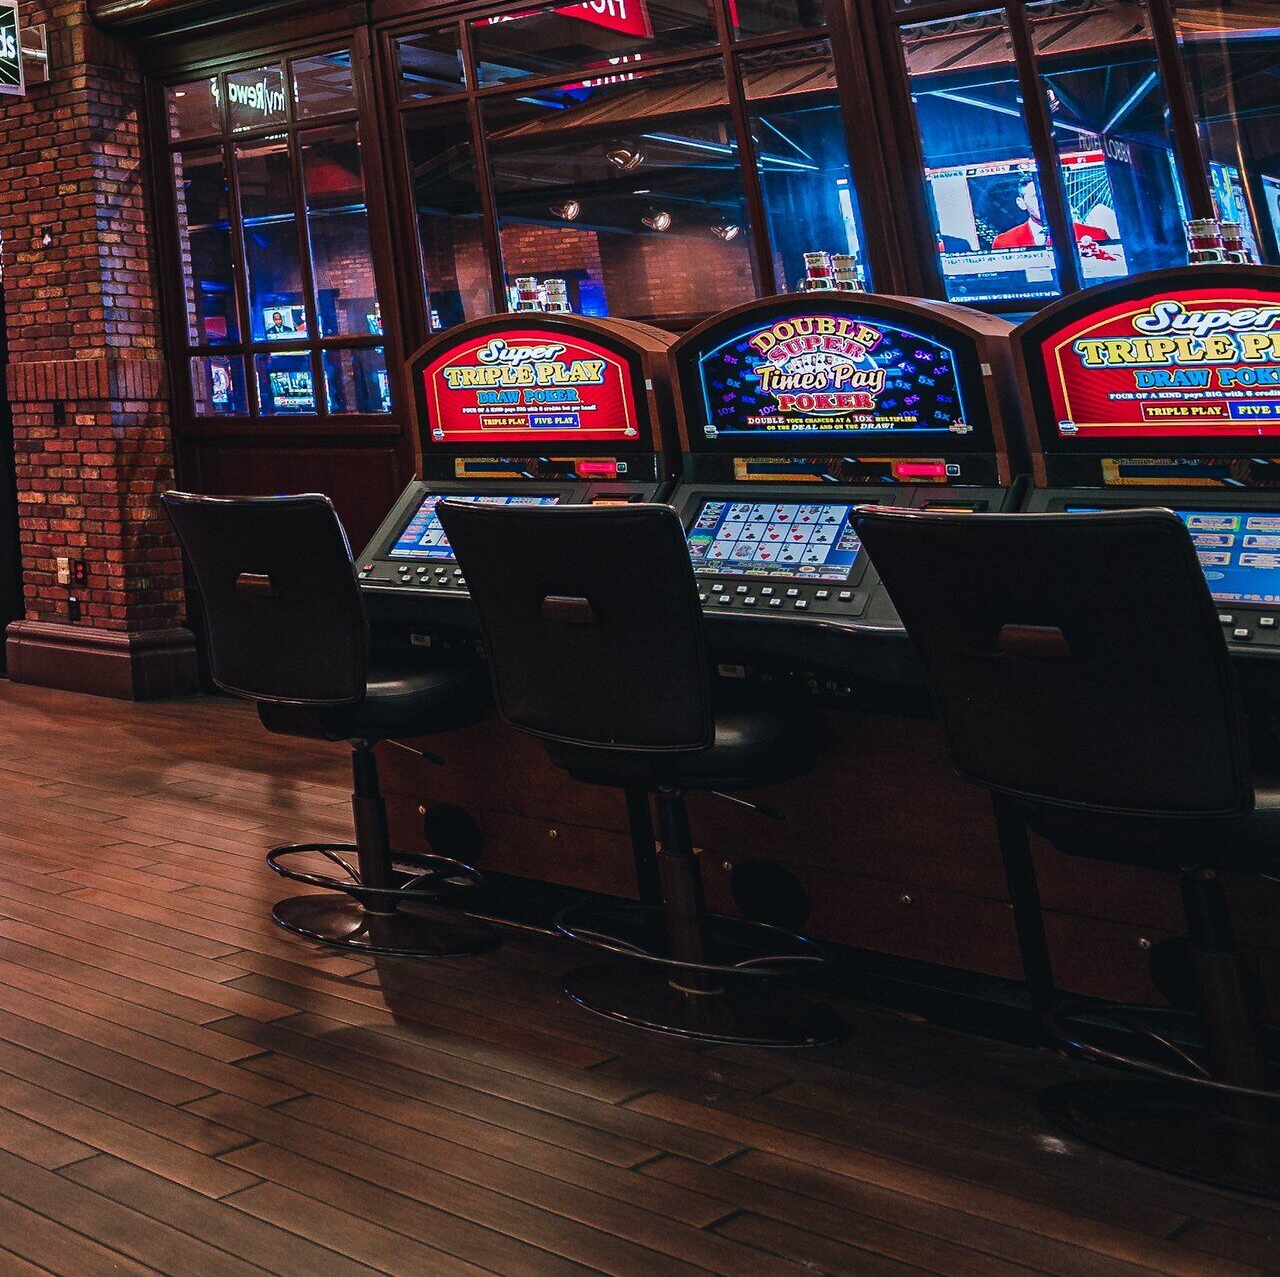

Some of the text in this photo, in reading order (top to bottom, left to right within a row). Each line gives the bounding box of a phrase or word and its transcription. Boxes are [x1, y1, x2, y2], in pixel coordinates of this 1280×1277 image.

[1133, 300, 1280, 335] Super
[749, 317, 881, 354] DOUBLE
[768, 334, 866, 363] SUPER
[478, 339, 566, 365] Super
[1076, 335, 1237, 366] TRIPLE
[446, 362, 604, 388] TRIPLE PLAY
[755, 362, 886, 394] Times Pay
[1135, 367, 1280, 389] DRAW POK
[477, 388, 578, 405] DRAW POKER
[778, 393, 875, 412] POKER
[1147, 407, 1221, 415] TRIPLE PLAY
[1238, 406, 1271, 414] FIVE
